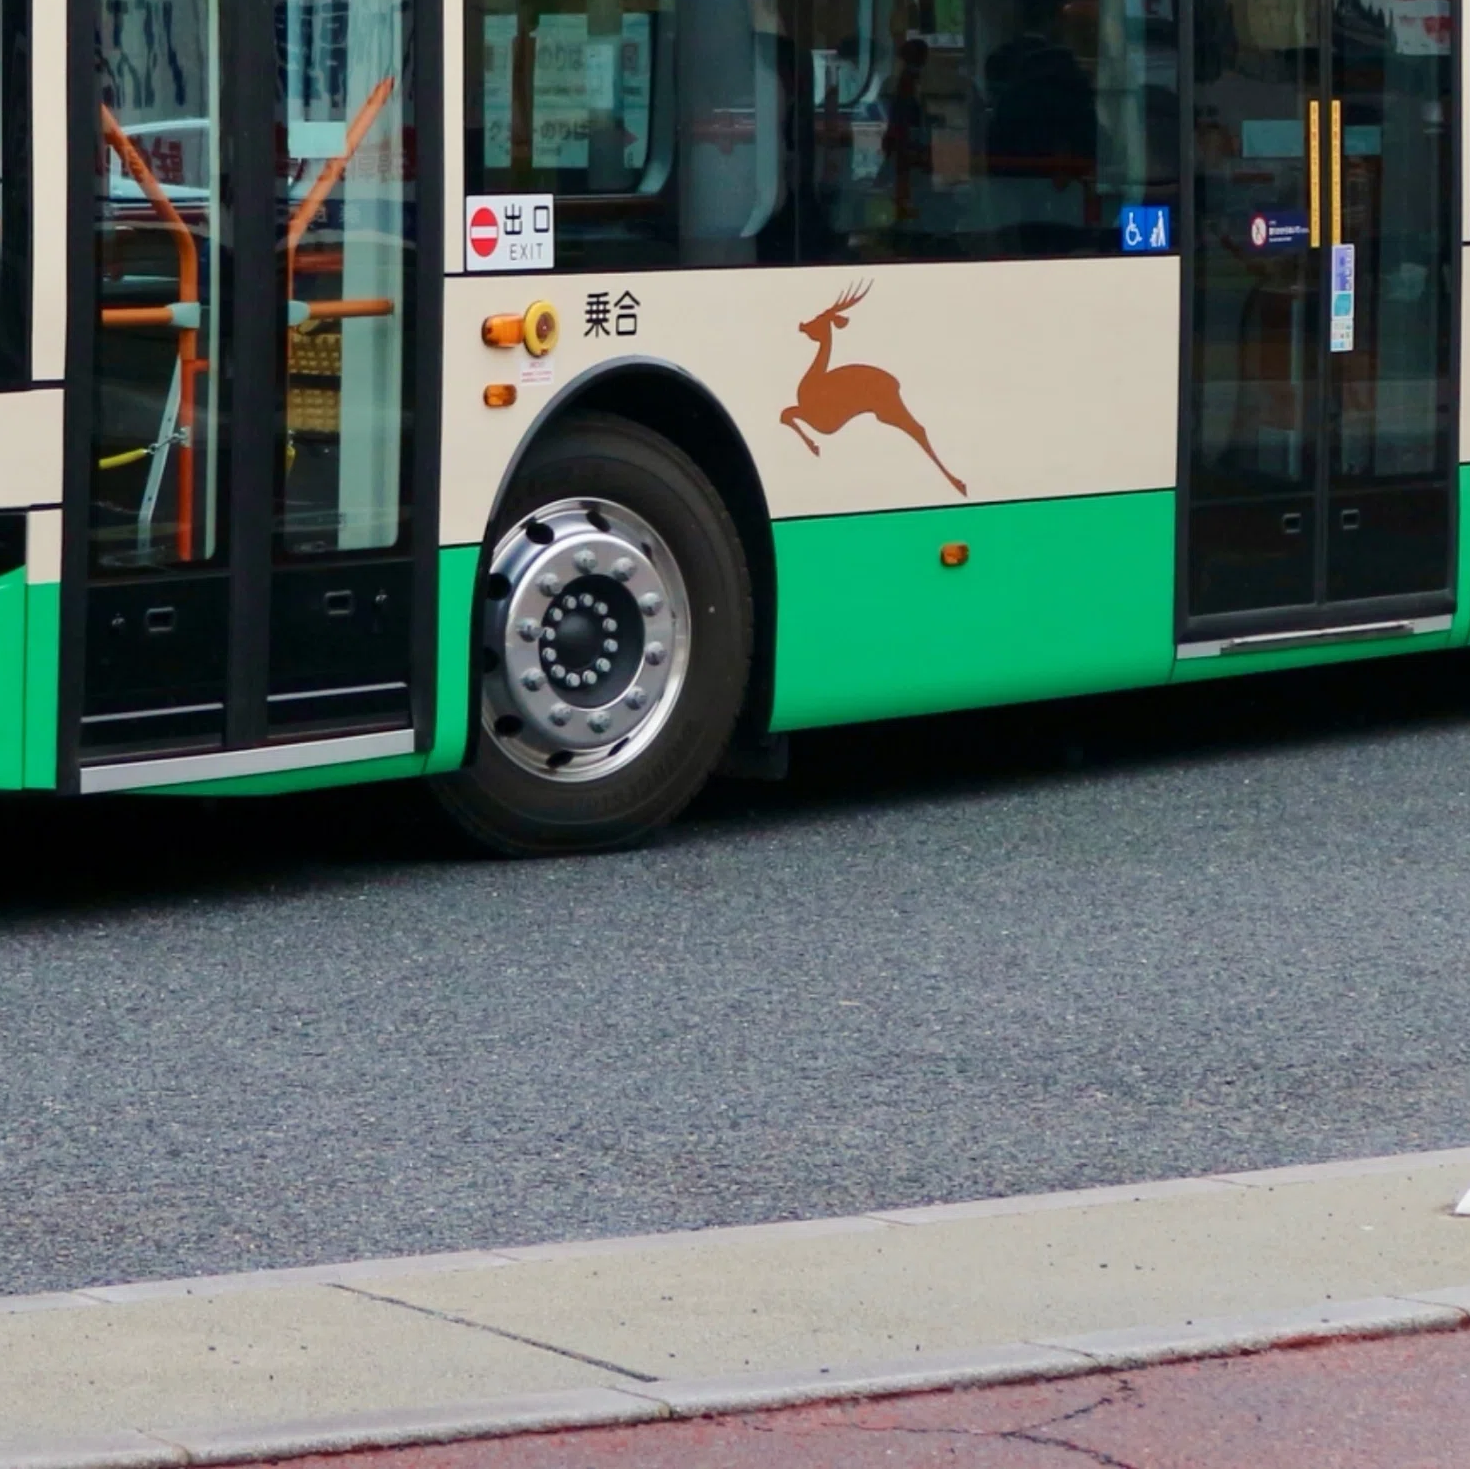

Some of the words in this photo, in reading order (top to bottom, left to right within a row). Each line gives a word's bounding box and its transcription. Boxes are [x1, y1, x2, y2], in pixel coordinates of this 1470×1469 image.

[503, 203, 551, 236] 出口
[509, 242, 544, 261] EXIT
[583, 289, 642, 338] 乗合
